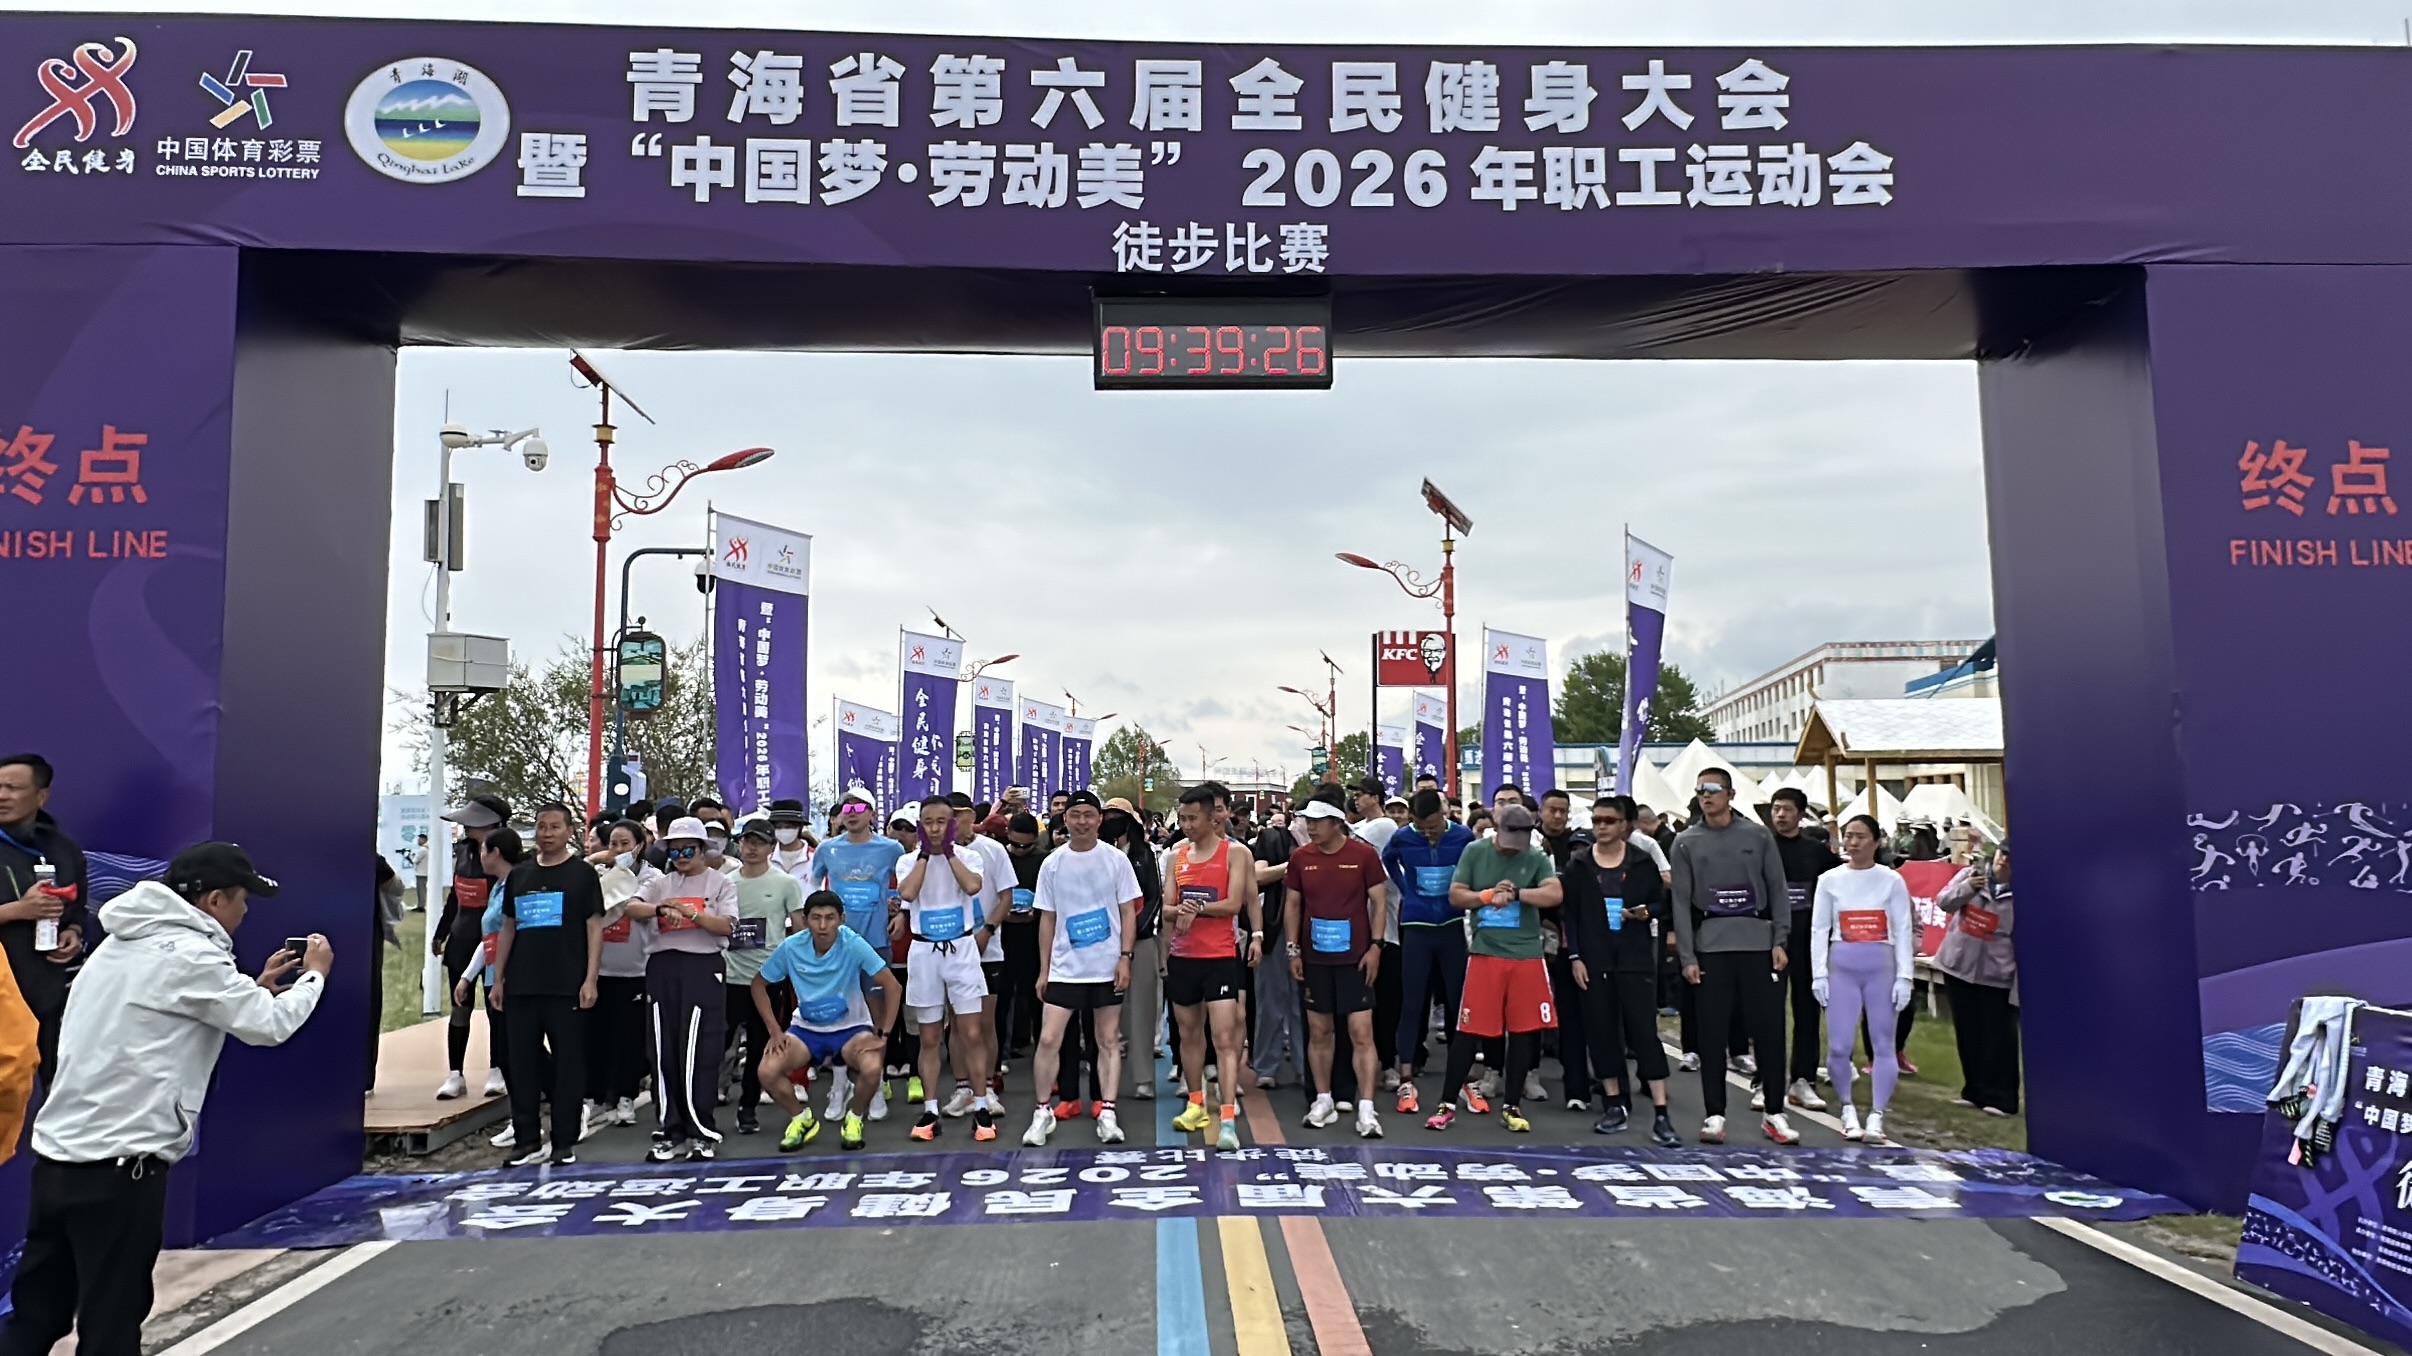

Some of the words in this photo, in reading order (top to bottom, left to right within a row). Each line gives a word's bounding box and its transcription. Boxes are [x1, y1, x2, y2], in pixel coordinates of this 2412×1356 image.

[390, 63, 469, 86] 青海湖
[627, 48, 1790, 134] 青海省第六届全民健身大会
[21, 148, 136, 175] 全民健身
[157, 136, 322, 164] 中国体育彩票
[377, 152, 437, 176] Qinghai
[156, 165, 198, 178] CHINA
[201, 166, 255, 179] SPORTS
[258, 167, 320, 180] LOTTERY
[516, 132, 587, 199] 暨
[1242, 148, 1448, 208] 2026
[1470, 141, 1895, 210] 年职工运动会
[1111, 220, 1331, 275] 徒步比赛
[1102, 326, 1325, 375] 09:39:26
[2238, 439, 2399, 517] 终点
[88, 530, 169, 559] LINE
[2230, 539, 2339, 566] FINISH
[1381, 648, 1418, 661] KFC
[912, 687, 931, 780] 全民健身
[1540, 1001, 1551, 1023] 8
